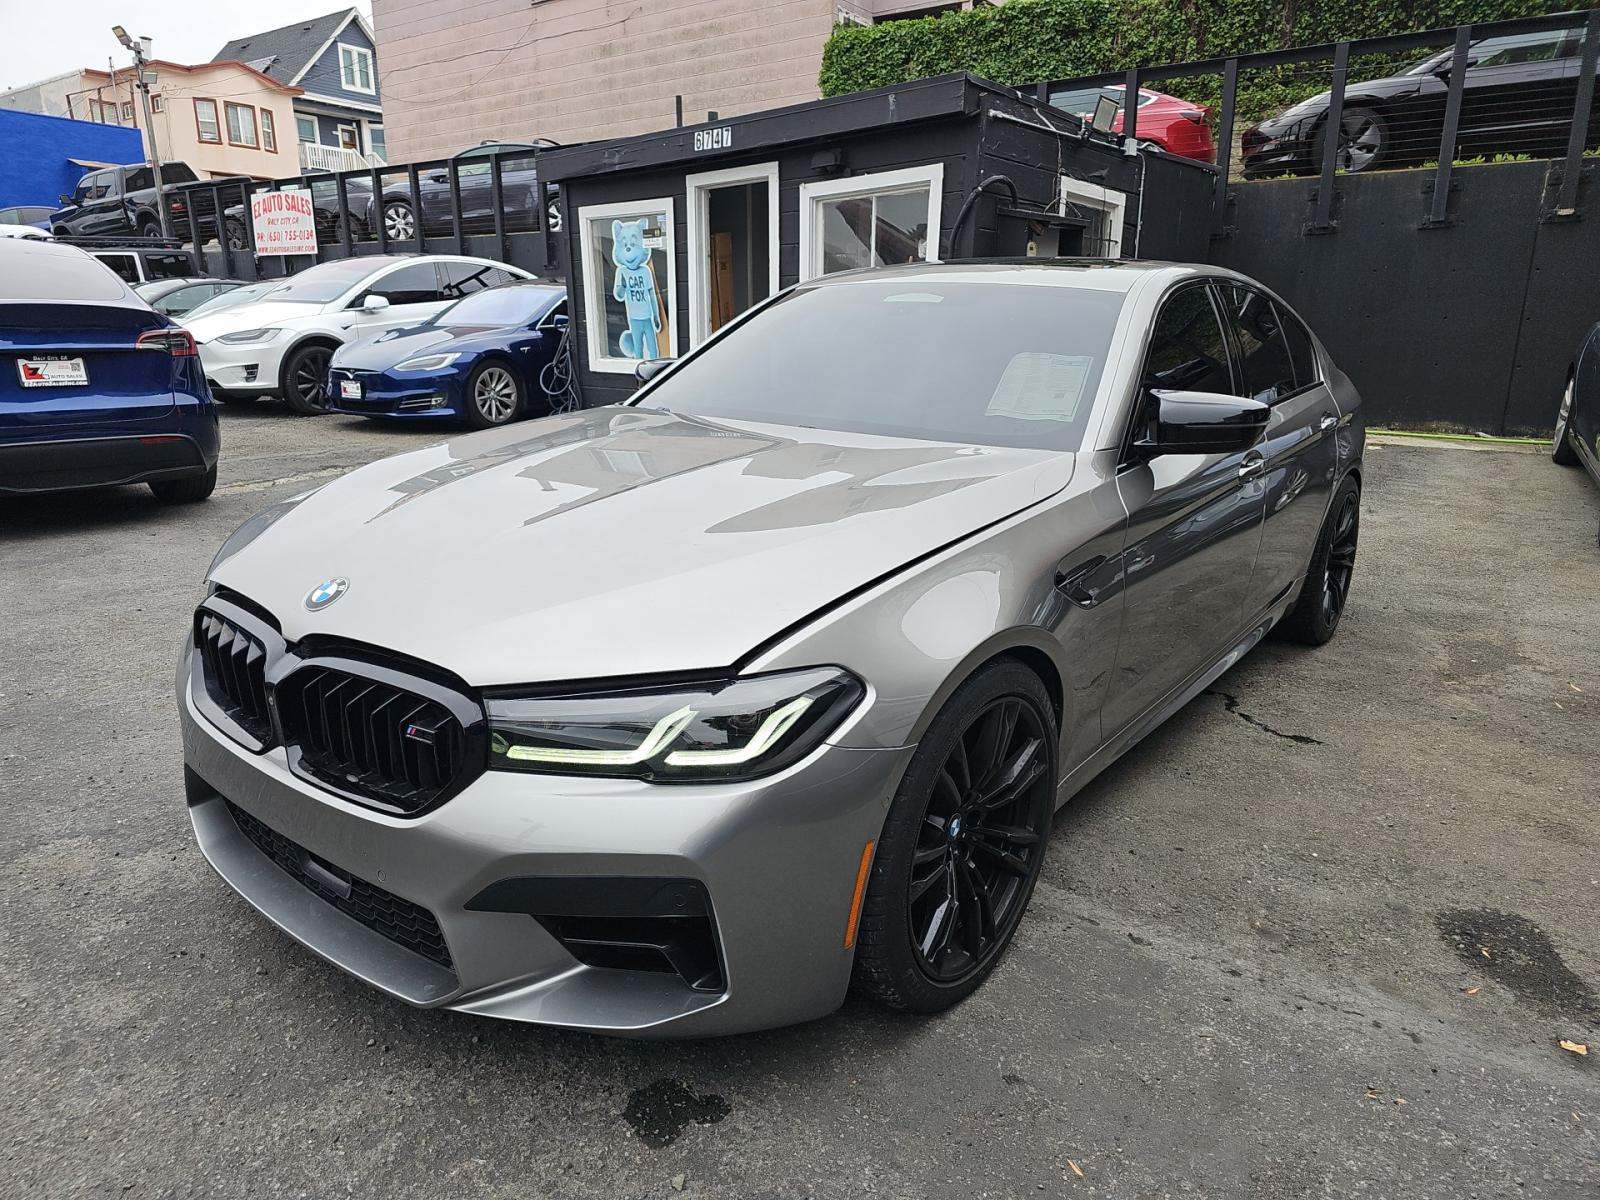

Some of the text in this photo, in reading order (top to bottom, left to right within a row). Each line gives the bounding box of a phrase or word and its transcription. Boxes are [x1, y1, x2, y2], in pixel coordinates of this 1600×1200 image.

[695, 128, 730, 149] 6747
[253, 194, 312, 219] EZ AUTO SALES
[266, 231, 282, 242] (650)
[284, 229, 314, 241] 755-0134
[628, 276, 645, 289] CAR
[630, 289, 646, 302] FOX
